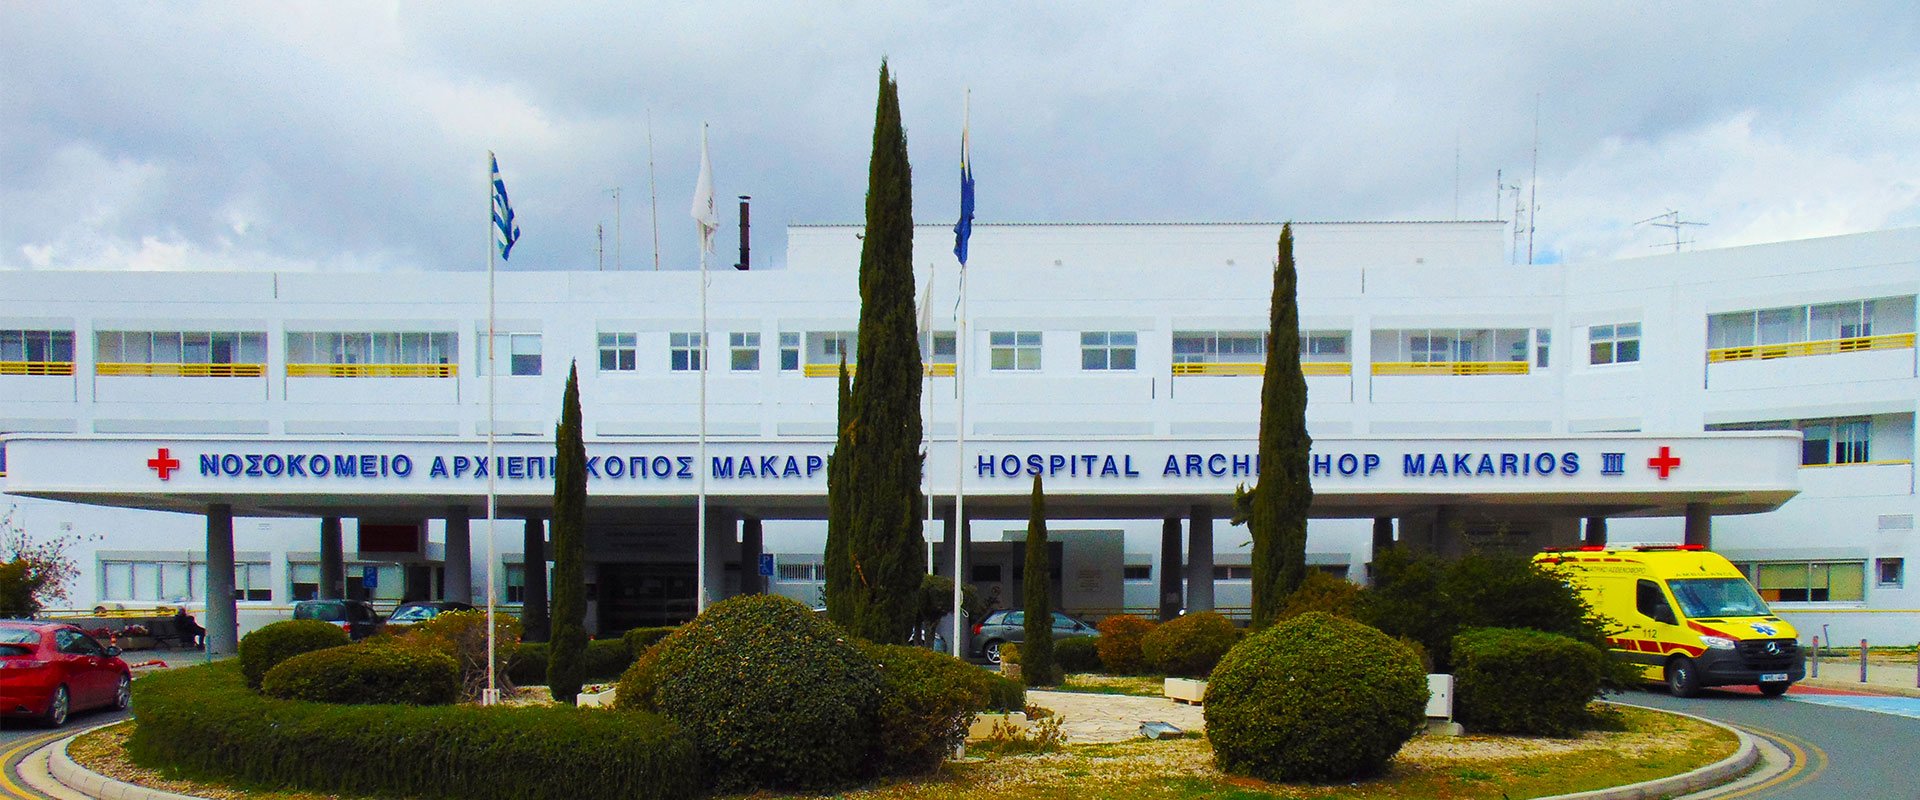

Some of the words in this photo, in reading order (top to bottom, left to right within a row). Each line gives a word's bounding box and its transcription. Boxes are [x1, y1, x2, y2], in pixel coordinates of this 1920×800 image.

[200, 455, 412, 478] ΝΟΣΟΚΟΜΕΙΟ
[430, 456, 693, 480] ΑΡΧΙΕΠΙΚΟΠΟΣ
[712, 456, 823, 479] ΜΑΚΑΡ
[978, 455, 1139, 477] HOSPITAL
[1163, 454, 1380, 477] ARCHHOP
[1403, 453, 1580, 476] MAKARIOS
[1601, 453, 1625, 476] III
[1642, 628, 1658, 639] 112
